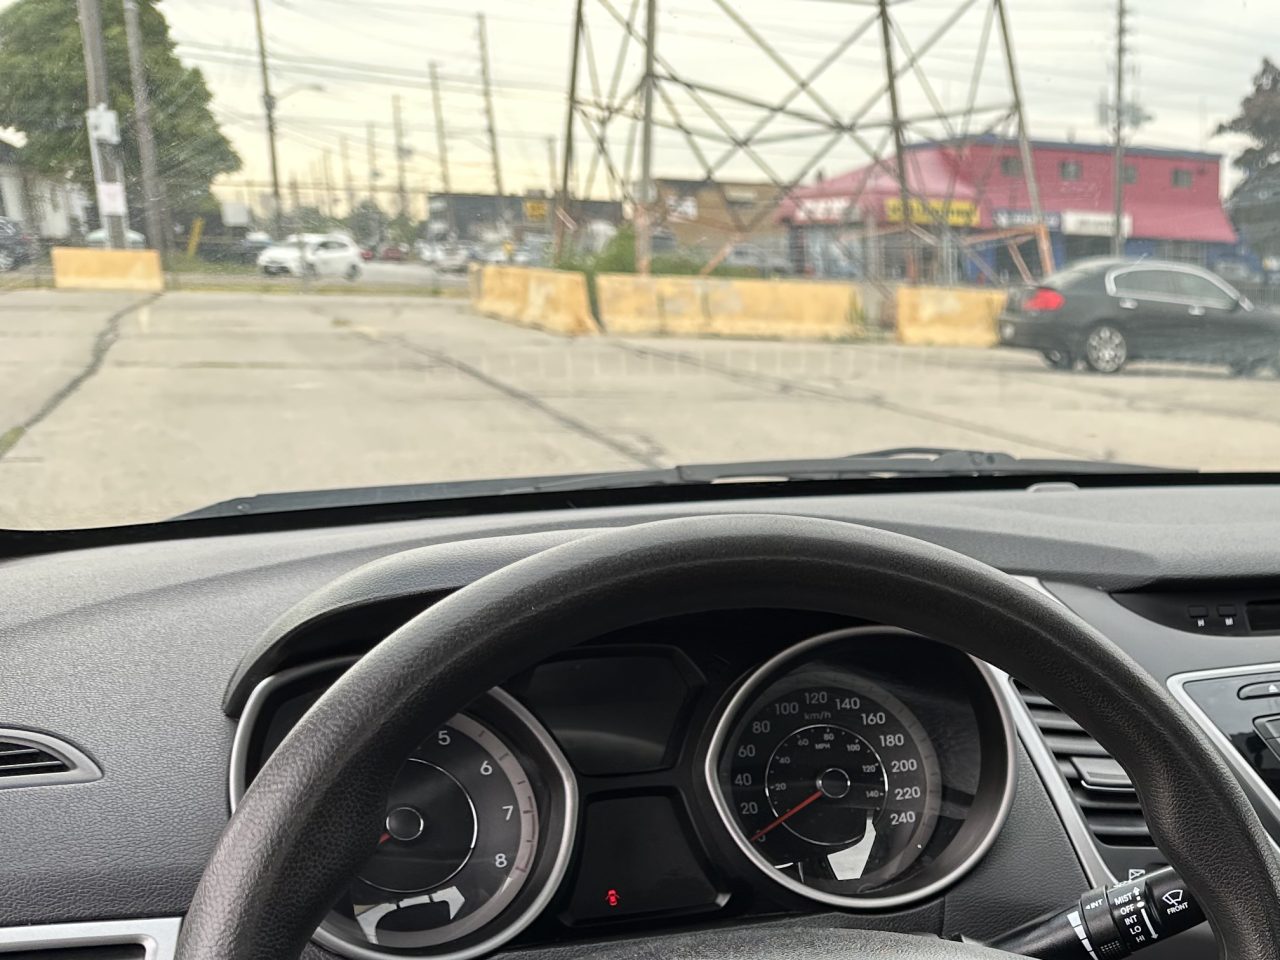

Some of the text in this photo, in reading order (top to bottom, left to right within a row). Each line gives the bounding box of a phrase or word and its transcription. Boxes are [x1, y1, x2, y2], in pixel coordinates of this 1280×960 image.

[805, 691, 828, 705] 120
[836, 697, 861, 711] 140
[775, 702, 799, 716] 100
[804, 711, 832, 721] km/h
[861, 712, 886, 726] 160
[752, 720, 771, 735] 80
[438, 730, 451, 746] 5
[797, 738, 809, 747] 60
[824, 733, 835, 742] 80
[879, 733, 905, 748] 180
[738, 744, 756, 758] 60
[847, 743, 861, 752] 100
[779, 756, 791, 765] 40
[891, 759, 918, 773] 200
[480, 760, 493, 776] 6
[862, 764, 876, 774] 120
[734, 772, 753, 786] 40
[776, 782, 787, 791] 20
[894, 786, 921, 801] 220
[866, 790, 879, 799] 140
[502, 805, 514, 821] 7
[740, 801, 758, 815] 20
[890, 811, 917, 825] 240
[495, 853, 508, 868] 8
[1090, 899, 1104, 910] INT
[1114, 892, 1133, 906] MIST
[1120, 904, 1135, 916] OFF
[1167, 901, 1189, 916] FRONT
[1124, 915, 1138, 926] INT
[1129, 925, 1142, 936] LO
[1135, 934, 1146, 943] HI
